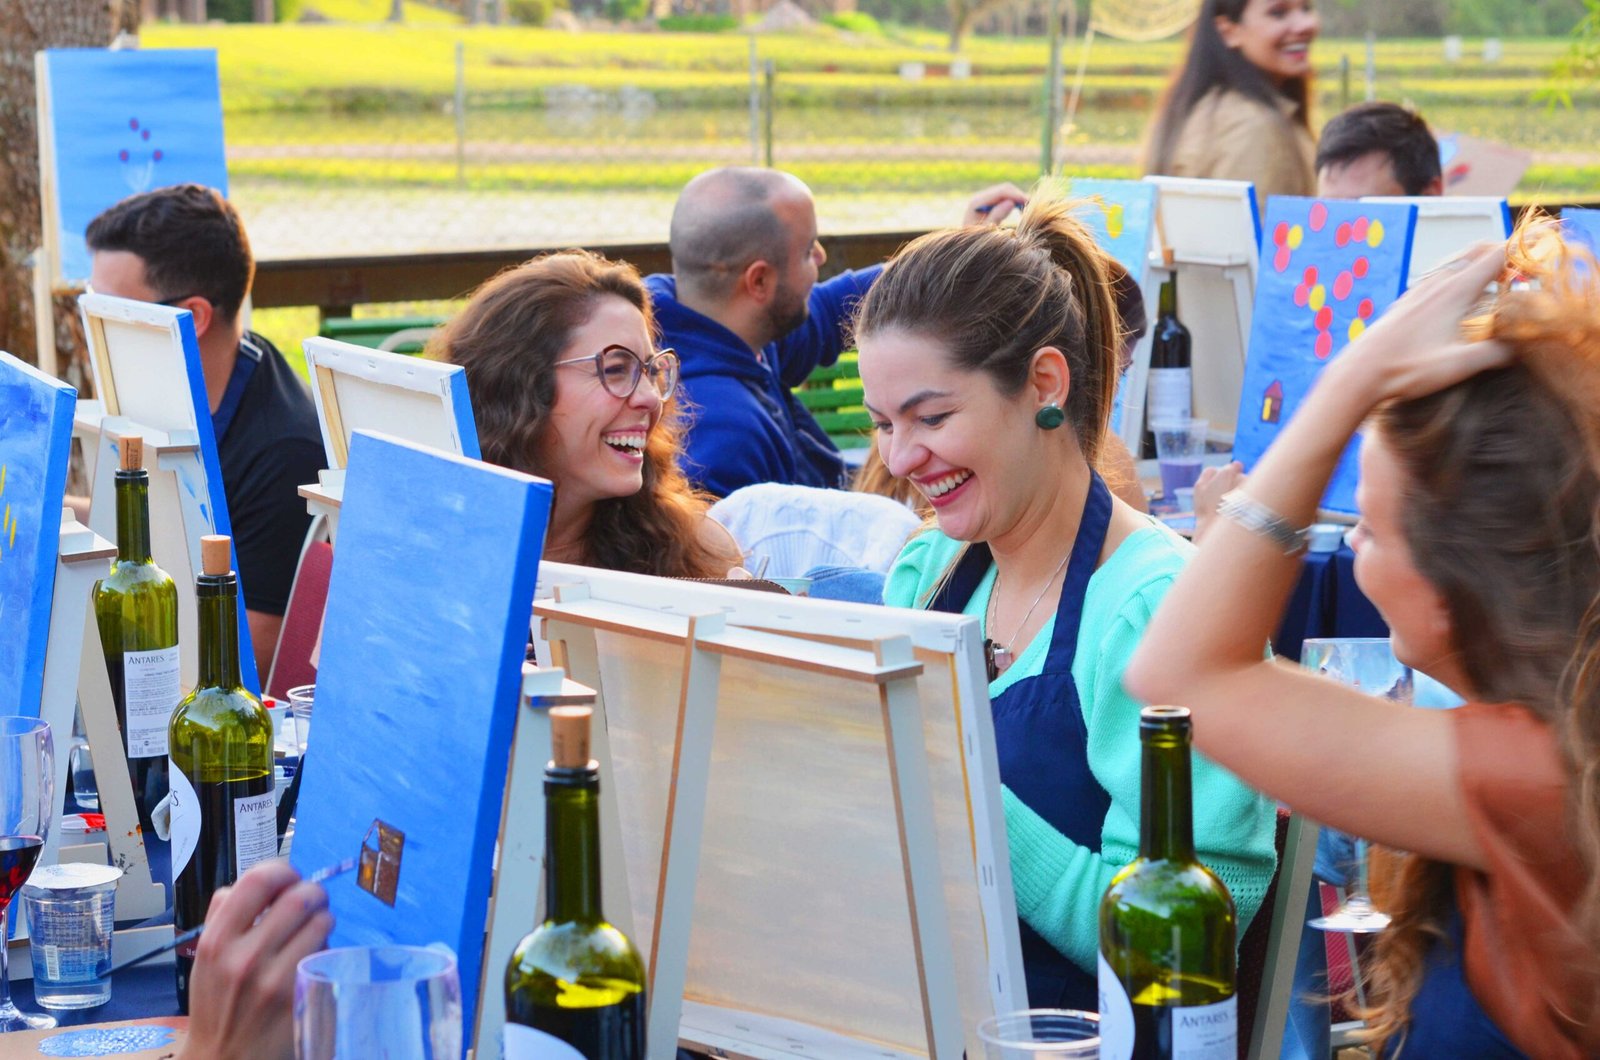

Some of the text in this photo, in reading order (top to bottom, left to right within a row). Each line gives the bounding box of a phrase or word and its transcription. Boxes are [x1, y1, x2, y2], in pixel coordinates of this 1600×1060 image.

[128, 655, 165, 664] ANTARES
[239, 799, 273, 813] ANTARES
[1180, 1011, 1229, 1028] ANTARES
